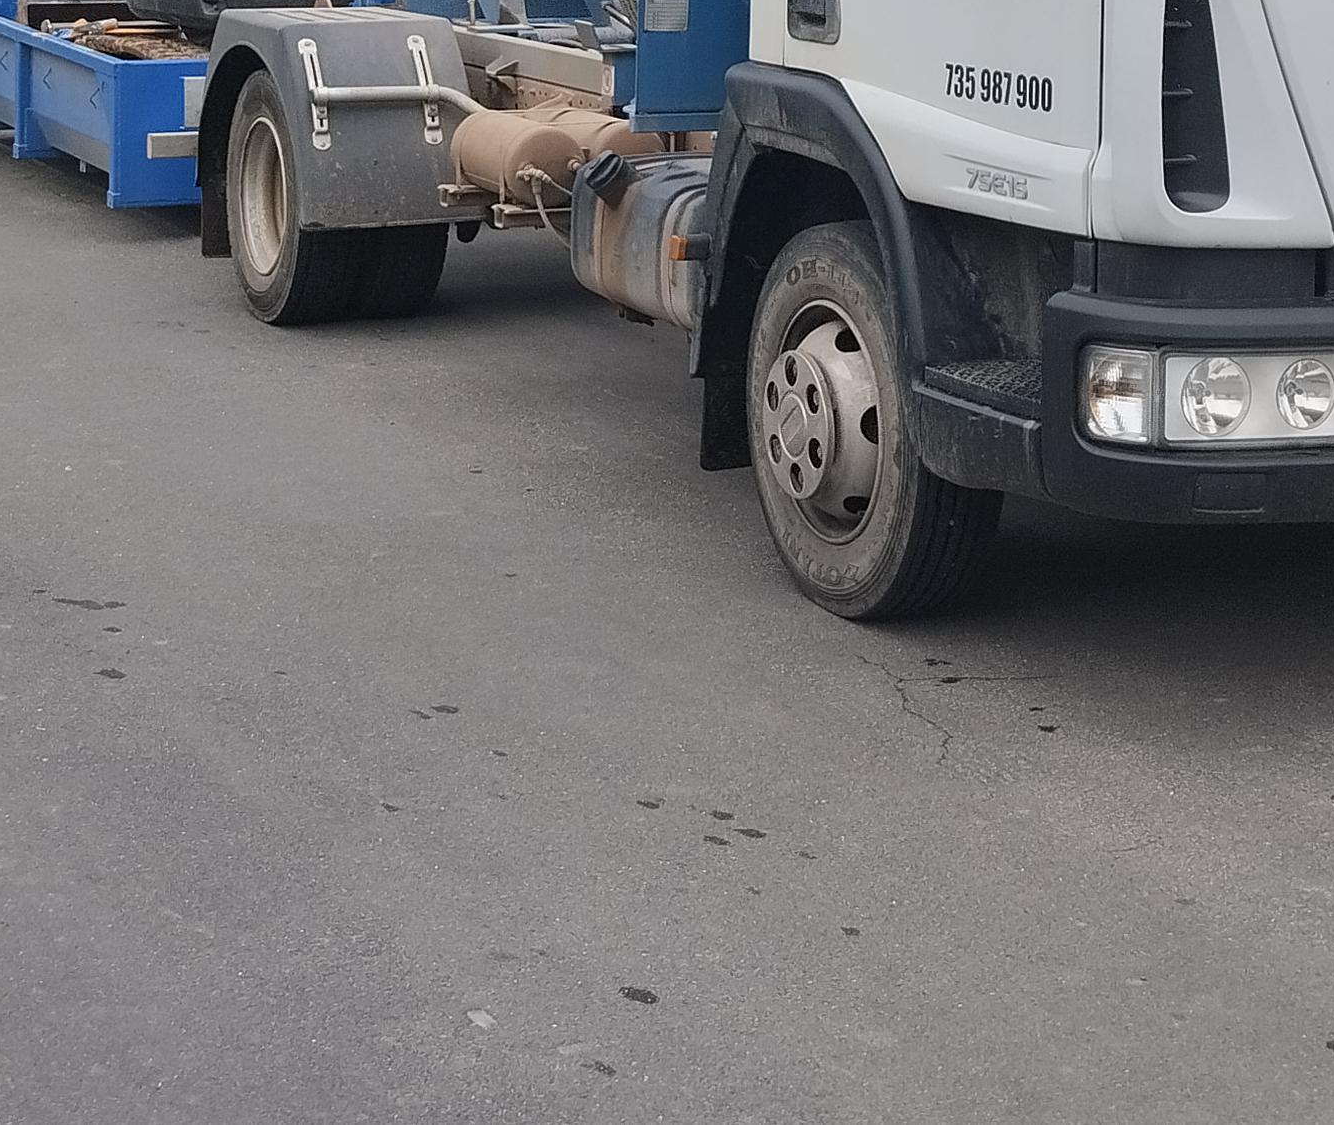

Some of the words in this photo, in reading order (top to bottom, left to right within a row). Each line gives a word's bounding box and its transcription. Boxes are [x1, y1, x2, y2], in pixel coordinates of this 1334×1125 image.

[945, 63, 975, 100] 735
[980, 68, 1012, 105] 987
[1016, 74, 1053, 112] 900
